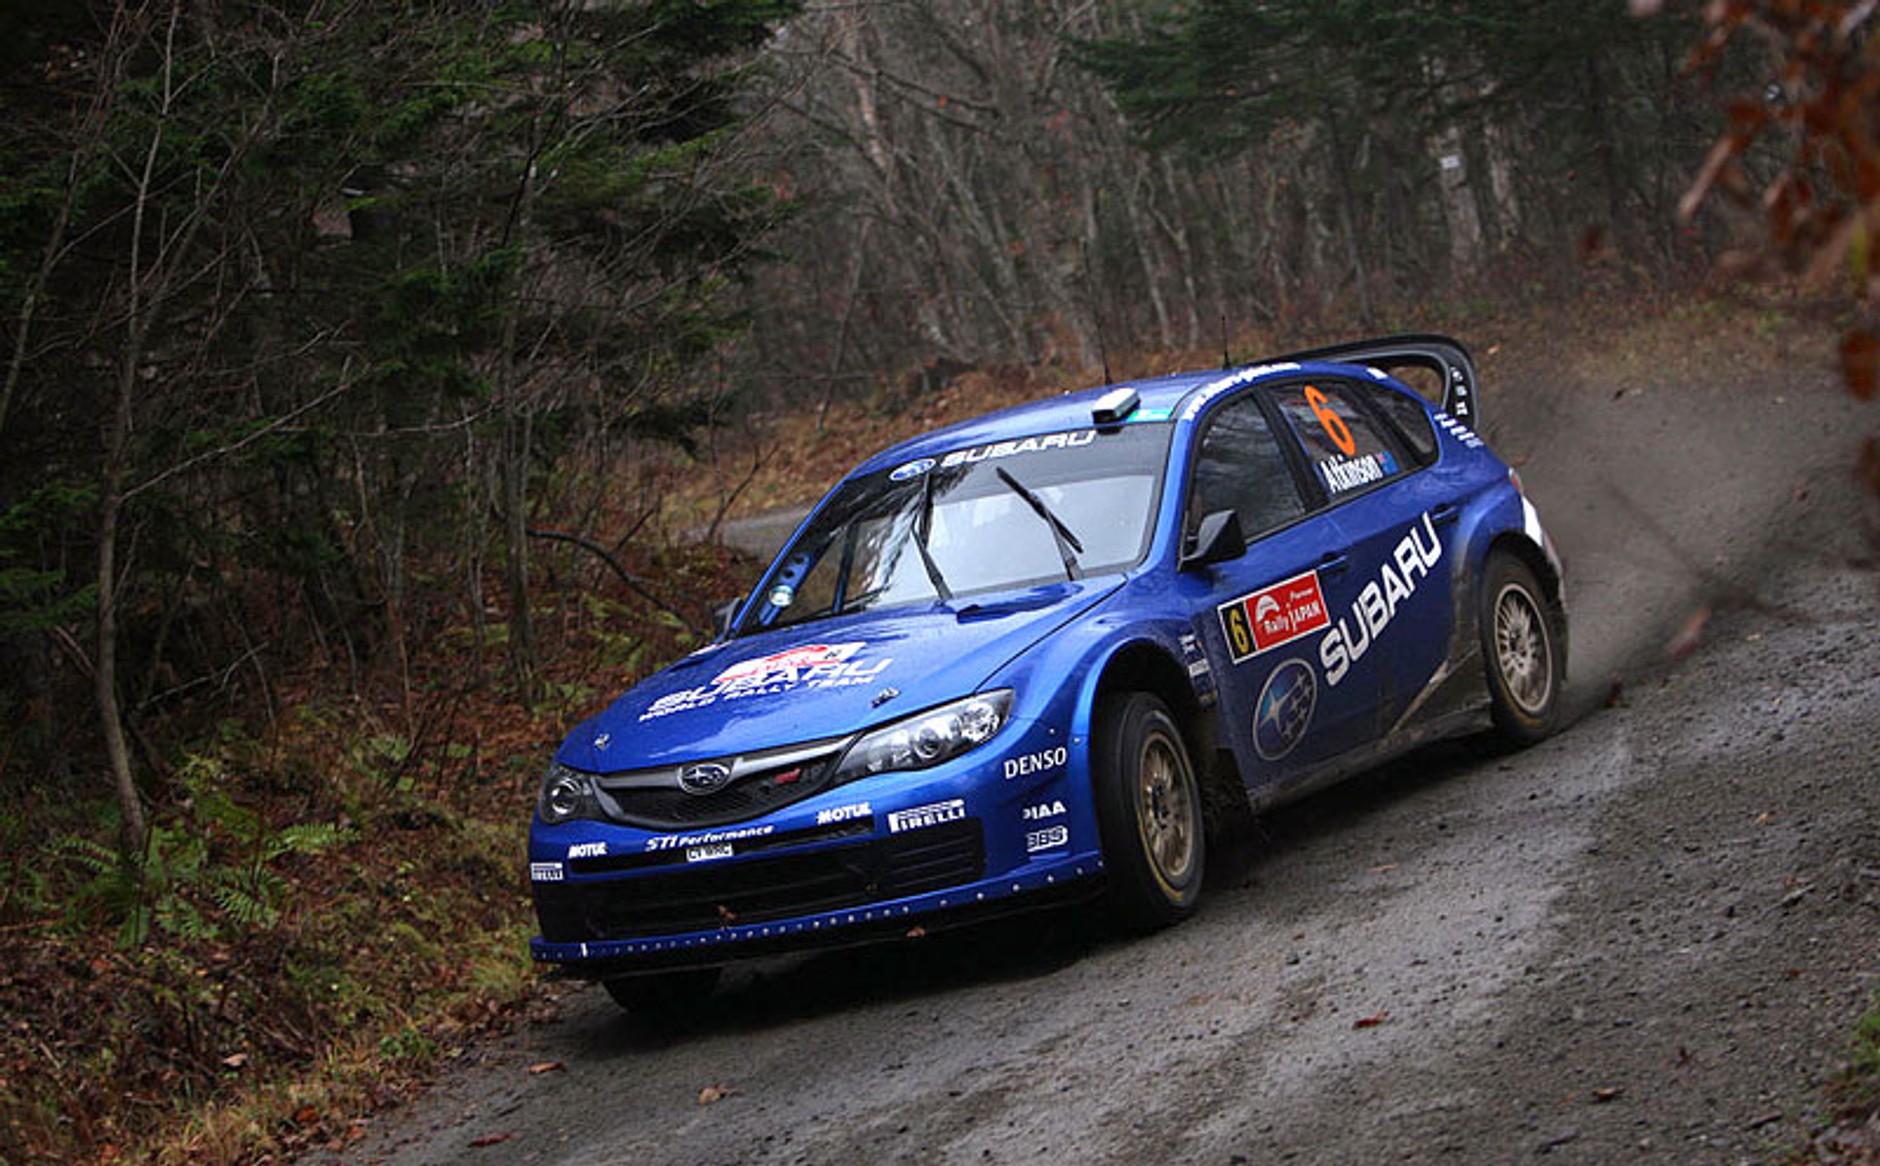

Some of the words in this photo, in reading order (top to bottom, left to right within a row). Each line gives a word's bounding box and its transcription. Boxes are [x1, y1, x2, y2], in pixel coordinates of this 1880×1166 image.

[1304, 385, 1356, 456] 6
[939, 430, 1097, 467] SUBARU
[1320, 454, 1383, 494] Atkinson
[1319, 511, 1442, 686] SUBARU
[1229, 609, 1249, 654] 6
[648, 658, 894, 712] SUBARU
[1004, 747, 1068, 779] DENSO
[817, 802, 873, 825] MOTUL
[888, 799, 966, 833] PIRELLI
[568, 842, 608, 859] MOTUL
[645, 835, 677, 852] STI
[679, 825, 774, 847] Performance
